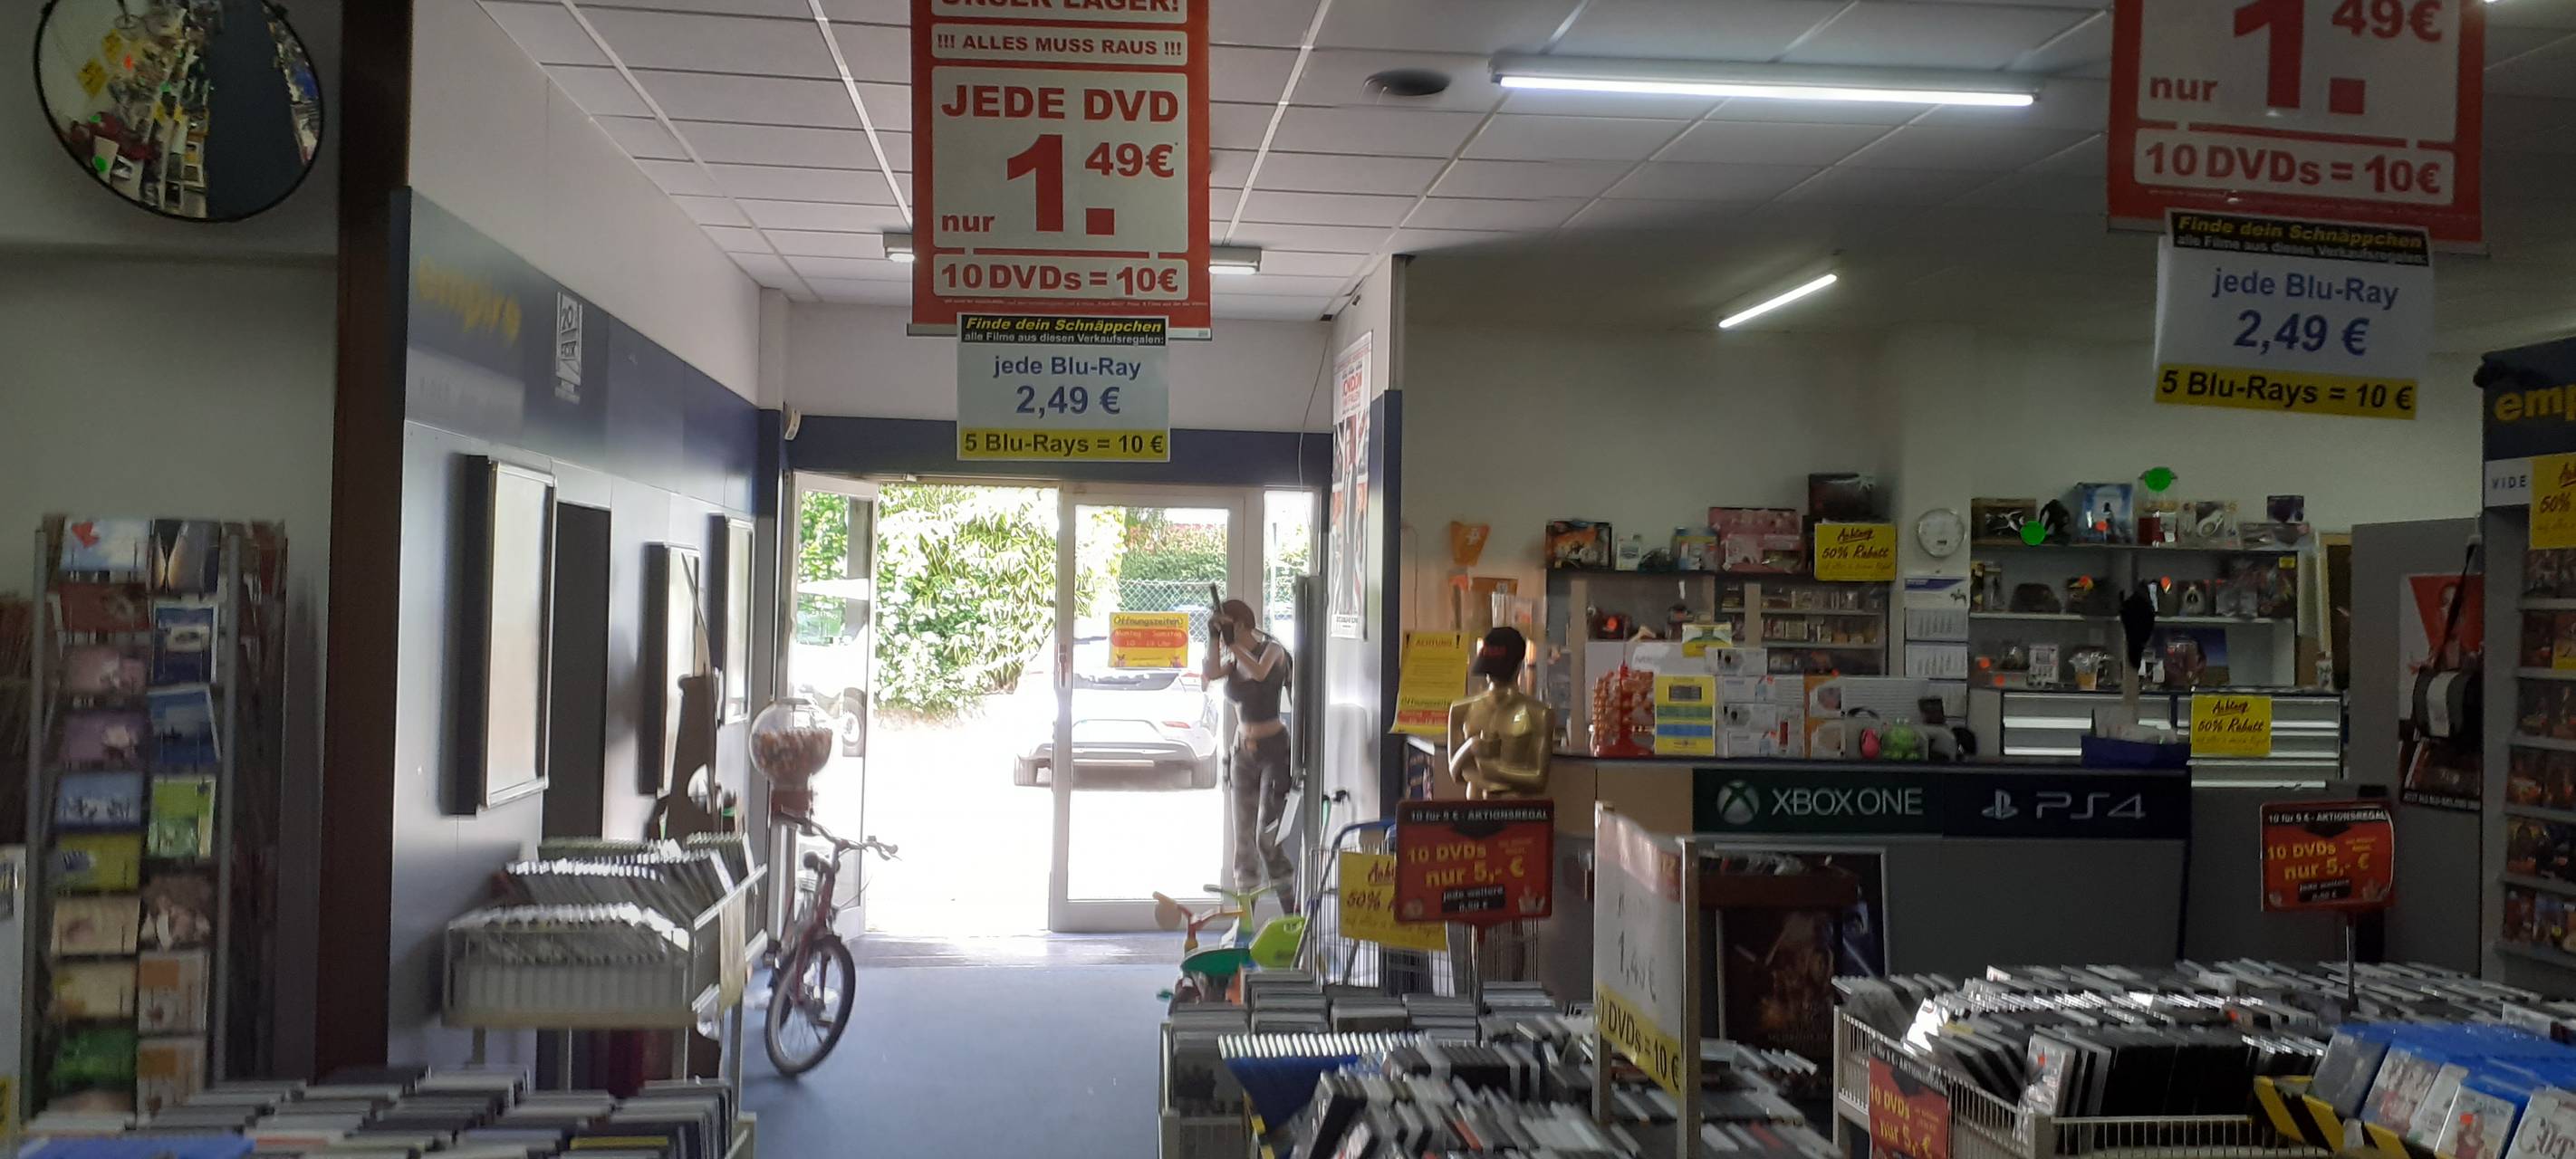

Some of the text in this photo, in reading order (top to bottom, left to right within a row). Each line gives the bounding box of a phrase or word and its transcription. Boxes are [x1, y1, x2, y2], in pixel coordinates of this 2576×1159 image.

[2331, 0, 2444, 43] 49€
[937, 34, 1182, 56] !!! ALLES MUSS RAUS !!!
[940, 84, 1178, 123] JEDE DVD
[2149, 76, 2218, 102] nur
[2146, 141, 2441, 195] 10 DVDs = 10€
[941, 214, 995, 233] nur
[2177, 215, 2235, 235] Finde
[2239, 221, 2283, 238] dein
[941, 263, 1179, 297] 10 DVDs = 10€
[2211, 267, 2399, 311] jede Blu-Ray
[964, 330, 1165, 346] alle Filme aus diesen Verkaufsregalen:
[965, 318, 1162, 334] Finde dein Schnäppchen
[2233, 309, 2370, 357] 2,49 €
[992, 355, 1141, 381] jede Blu-Ray
[1015, 385, 1121, 418] 2,49 €
[2161, 369, 2414, 410] 5 Blu-Rays = 10 €
[964, 432, 1165, 457] 5 Blu-Rays = 10 €
[1821, 544, 1889, 560] 50% Rabatt
[2227, 717, 2264, 733] Rabatt
[1771, 787, 1925, 816] XBOX ONE
[2034, 790, 2147, 819] PS4
[1407, 845, 1429, 863] 10
[1436, 840, 1486, 861] DVDs
[2267, 843, 2287, 860] 10
[2292, 839, 2337, 858] DVDs
[1426, 867, 1466, 887] nur
[1509, 855, 1525, 879] €
[2283, 863, 2320, 882] nur
[2357, 852, 2370, 870] €
[1347, 890, 1381, 911] 50%
[1608, 999, 1641, 1054] DVDs
[1654, 1039, 1668, 1080] 10
[1671, 1055, 1679, 1092] €
[1883, 1089, 1910, 1121] DVDs
